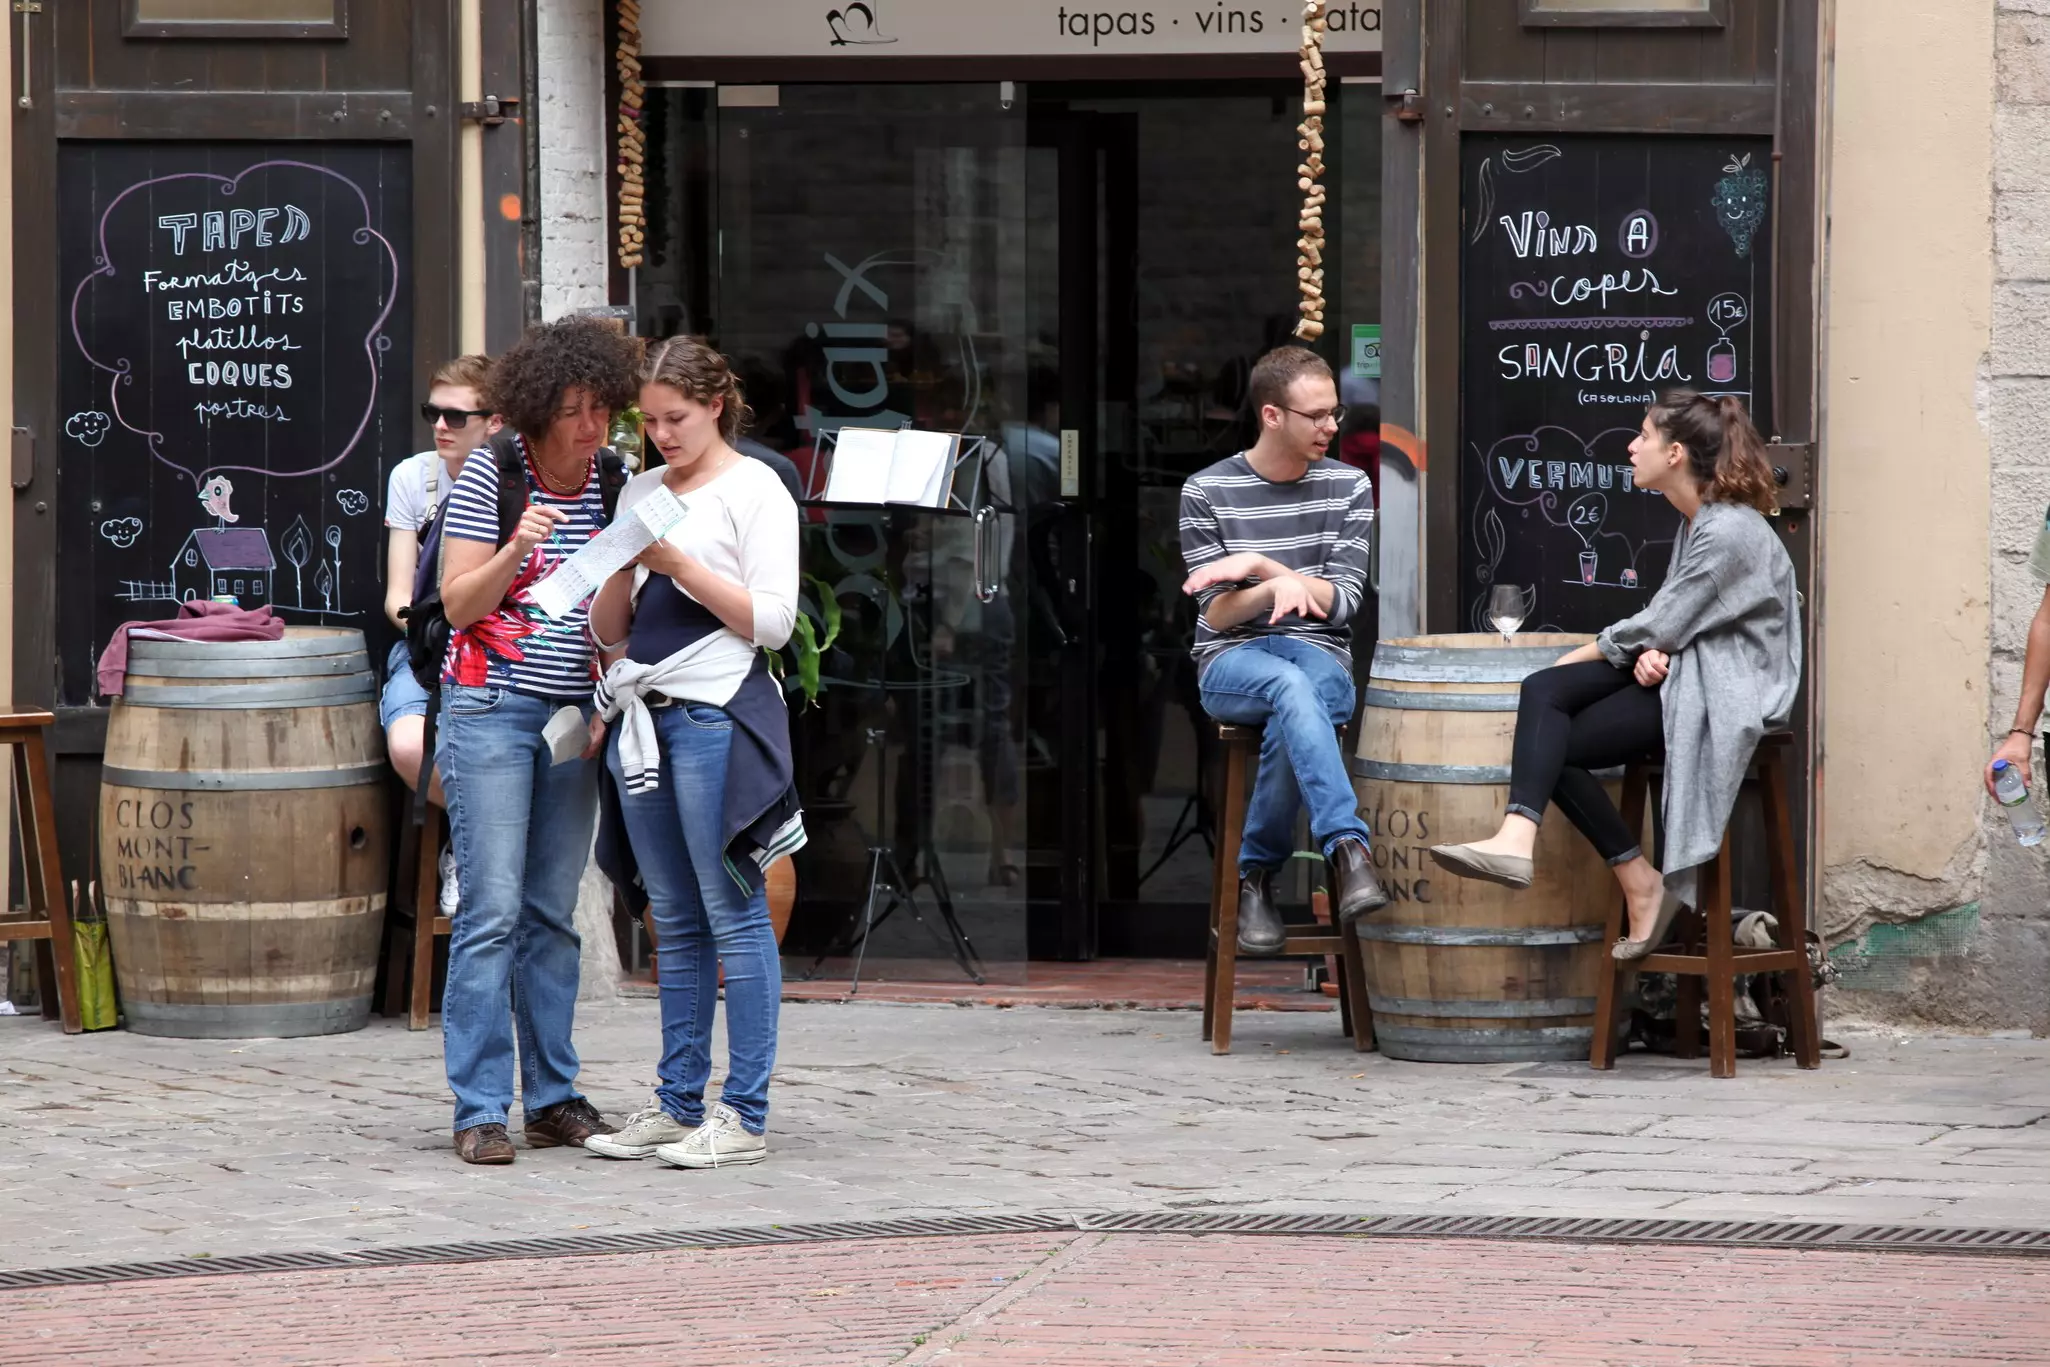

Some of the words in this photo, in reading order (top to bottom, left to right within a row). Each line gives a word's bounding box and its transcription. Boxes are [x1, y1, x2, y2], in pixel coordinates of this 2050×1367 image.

[1058, 5, 1155, 46] tapas
[1195, 2, 1264, 34] vins
[1325, 1, 1381, 31] ata
[159, 205, 311, 255] TAPES
[1627, 217, 1648, 252] A
[1551, 268, 1678, 309] copes
[1710, 300, 1744, 320] 15€
[175, 325, 302, 359] platillos
[188, 361, 293, 388] COQUES
[194, 397, 292, 424] postres
[1498, 456, 1663, 496] VERMUT
[1574, 506, 1600, 525] 2€
[117, 799, 194, 830] CLOS
[117, 835, 211, 860] MONT-
[118, 864, 197, 891] BLANC
